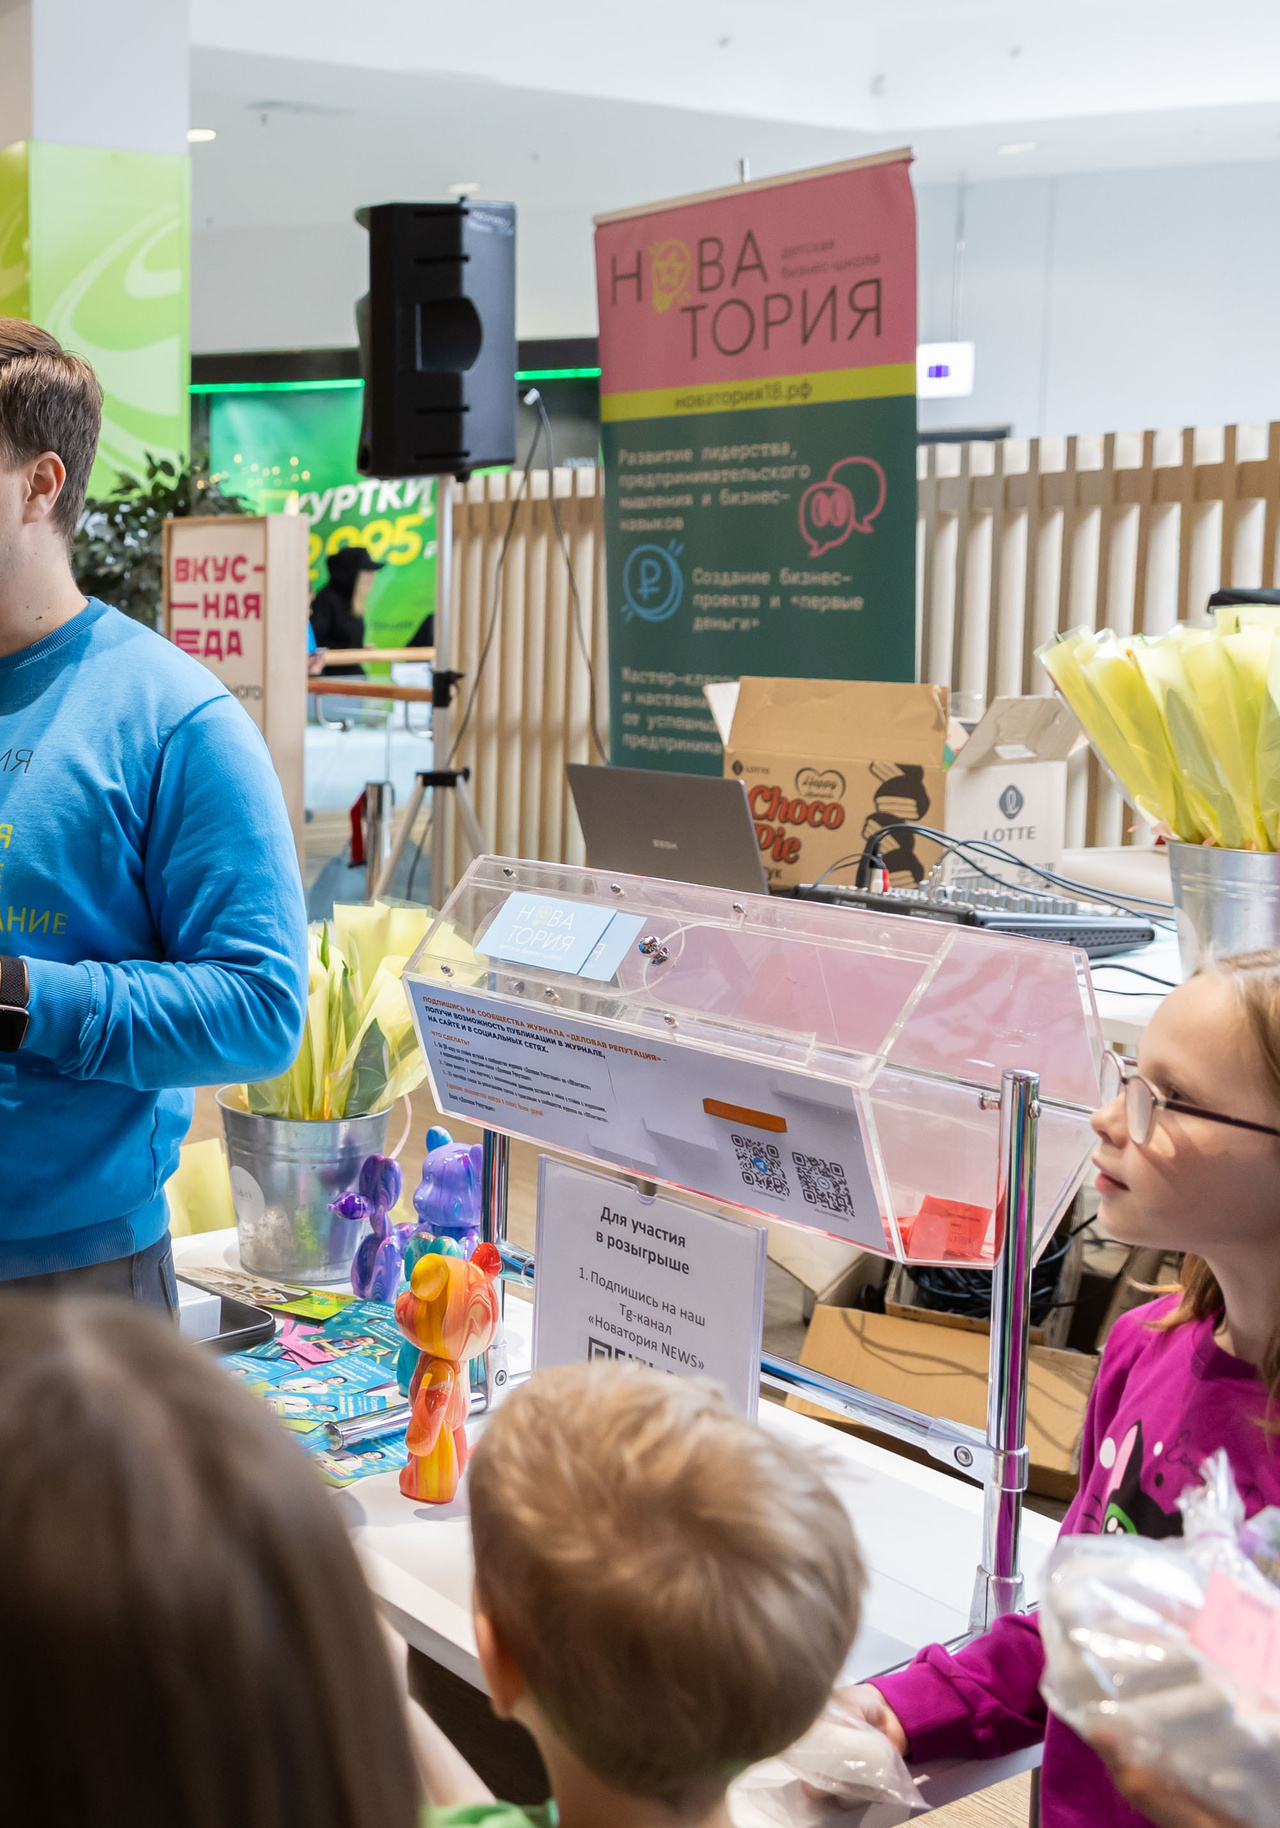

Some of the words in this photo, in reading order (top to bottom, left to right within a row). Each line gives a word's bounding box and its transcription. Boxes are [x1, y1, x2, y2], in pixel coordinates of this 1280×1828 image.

[681, 278, 881, 360] ТОРИЯ
[674, 379, 813, 409] новатория18.рф
[619, 449, 694, 466] Развитие
[701, 441, 798, 464] лидерства,
[620, 464, 811, 491] предпринимательского
[620, 493, 694, 510] мышления
[701, 494, 712, 507] и
[620, 515, 685, 532] навыков
[691, 567, 771, 586] Создание
[692, 594, 761, 611] проекта
[770, 596, 781, 609] и
[175, 628, 243, 662] ЕДА
[623, 712, 640, 726] от
[747, 784, 845, 830] Choco
[983, 826, 1037, 842] LOTTE
[507, 925, 576, 953] ТОРИЯ
[423, 996, 465, 1012] ПОДПИШИСЬ
[477, 1010, 525, 1027] СООБЩЕСТВА
[526, 1022, 565, 1037] ЖУРНАЛА
[566, 1034, 607, 1048] «ДЕЛОВАЯ
[609, 1044, 661, 1061] РЕПУТАЦИЯ»
[425, 1006, 452, 1017] ПОЛУЧИ
[453, 1013, 505, 1031] ВОЗМОЖНОСТЬ
[507, 1027, 556, 1046] ПУБЛИКАЦИИ
[565, 1042, 605, 1059] ЖУРНАЛЕ,
[427, 1015, 438, 1023] НА
[439, 1017, 460, 1029] САЙТЕ
[473, 1027, 522, 1045] СОЦИАЛЬНЫХ
[524, 1041, 549, 1053] СЕТЯХ.
[600, 1206, 627, 1227] Для
[631, 1219, 686, 1248] участия
[596, 1231, 604, 1242] в
[607, 1235, 690, 1274] розыгрыше
[579, 1267, 588, 1280] 1.
[590, 1271, 659, 1308] Подпишись
[662, 1301, 676, 1315] на
[680, 1308, 705, 1326] наш
[619, 1303, 672, 1335] Tg-канал
[588, 1314, 658, 1351] «Новатория
[661, 1342, 705, 1370] NEWS»
